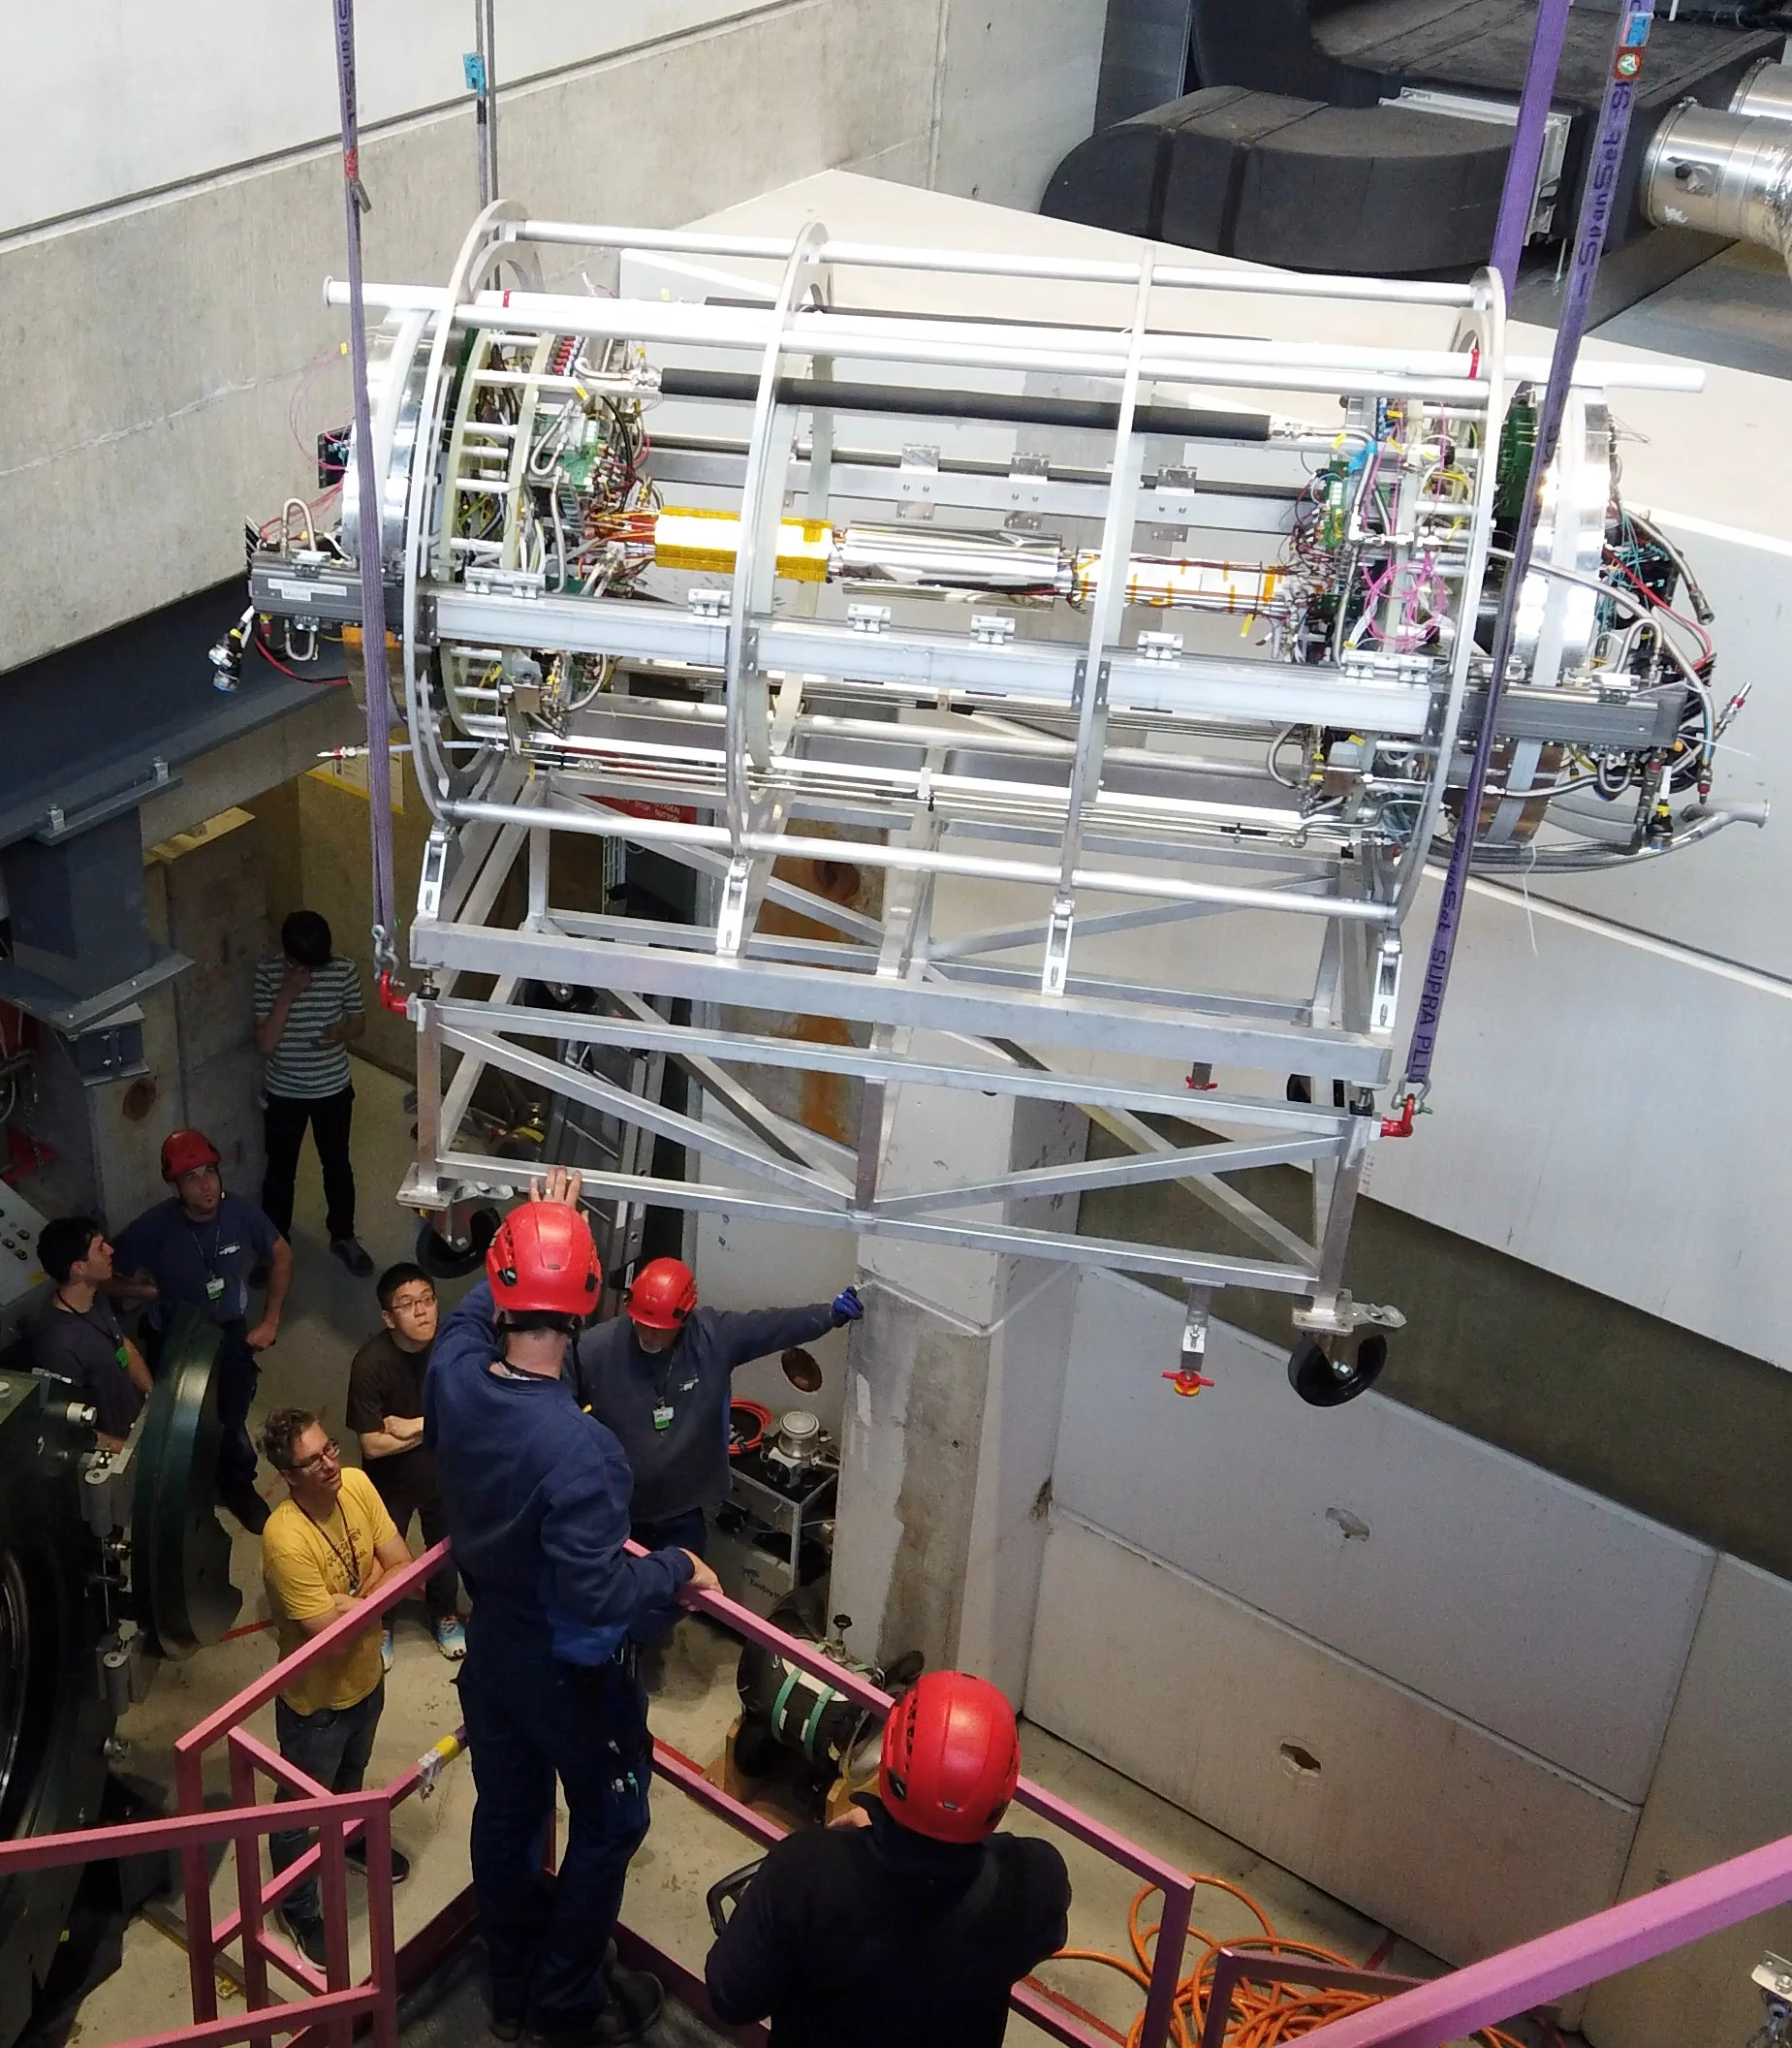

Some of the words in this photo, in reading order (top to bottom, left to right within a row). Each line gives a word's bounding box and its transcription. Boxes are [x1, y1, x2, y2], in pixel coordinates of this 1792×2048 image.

[1578, 131, 1621, 266] SpanSet
[1420, 947, 1447, 1025] SUPRA
[1411, 1034, 1432, 1082] PLU
